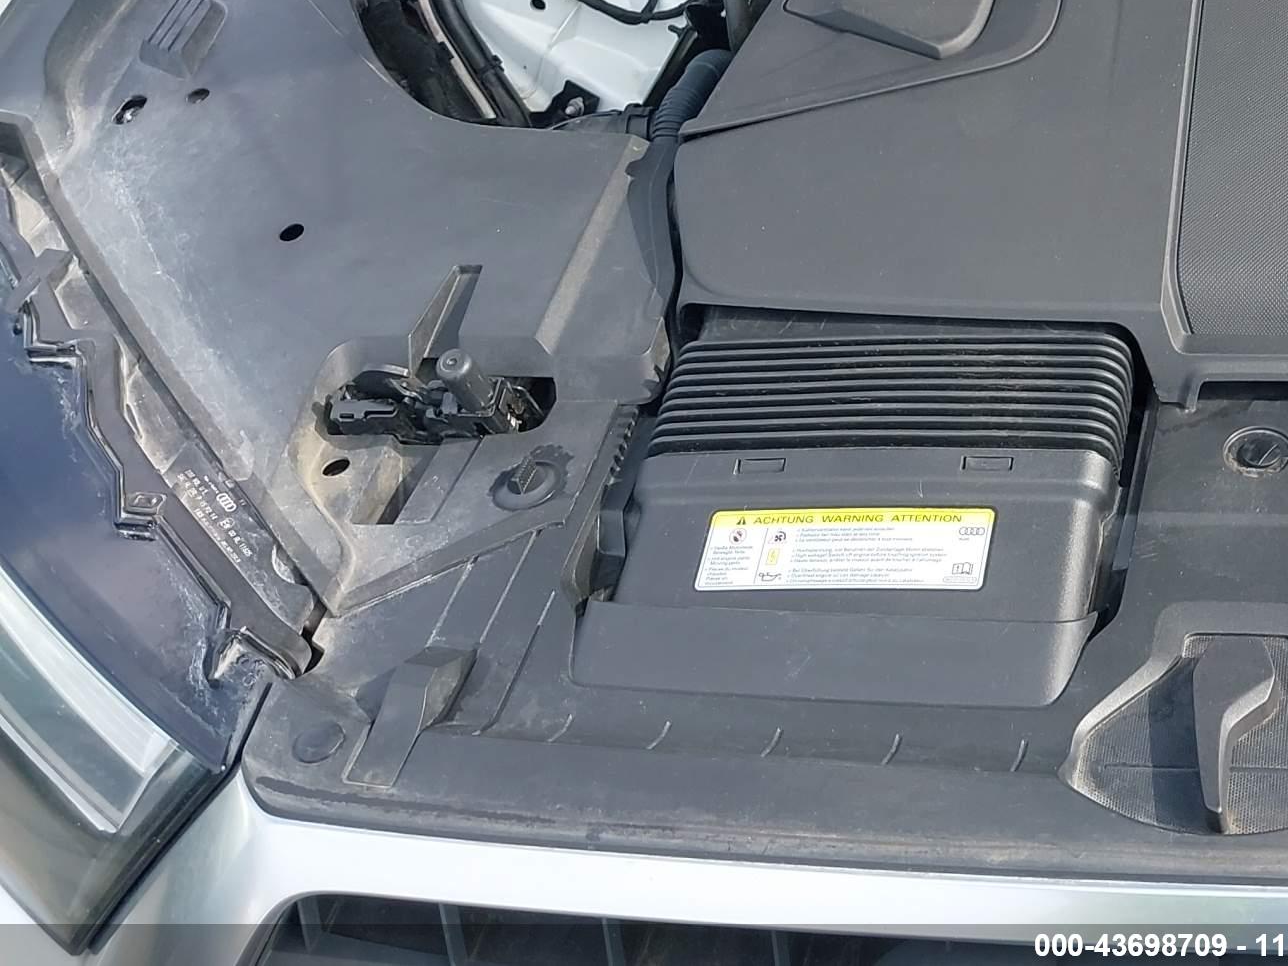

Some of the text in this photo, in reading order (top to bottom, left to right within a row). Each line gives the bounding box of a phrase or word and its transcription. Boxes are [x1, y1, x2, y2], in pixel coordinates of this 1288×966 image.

[753, 514, 963, 525] ACHTUNG WARNING ATTENTION
